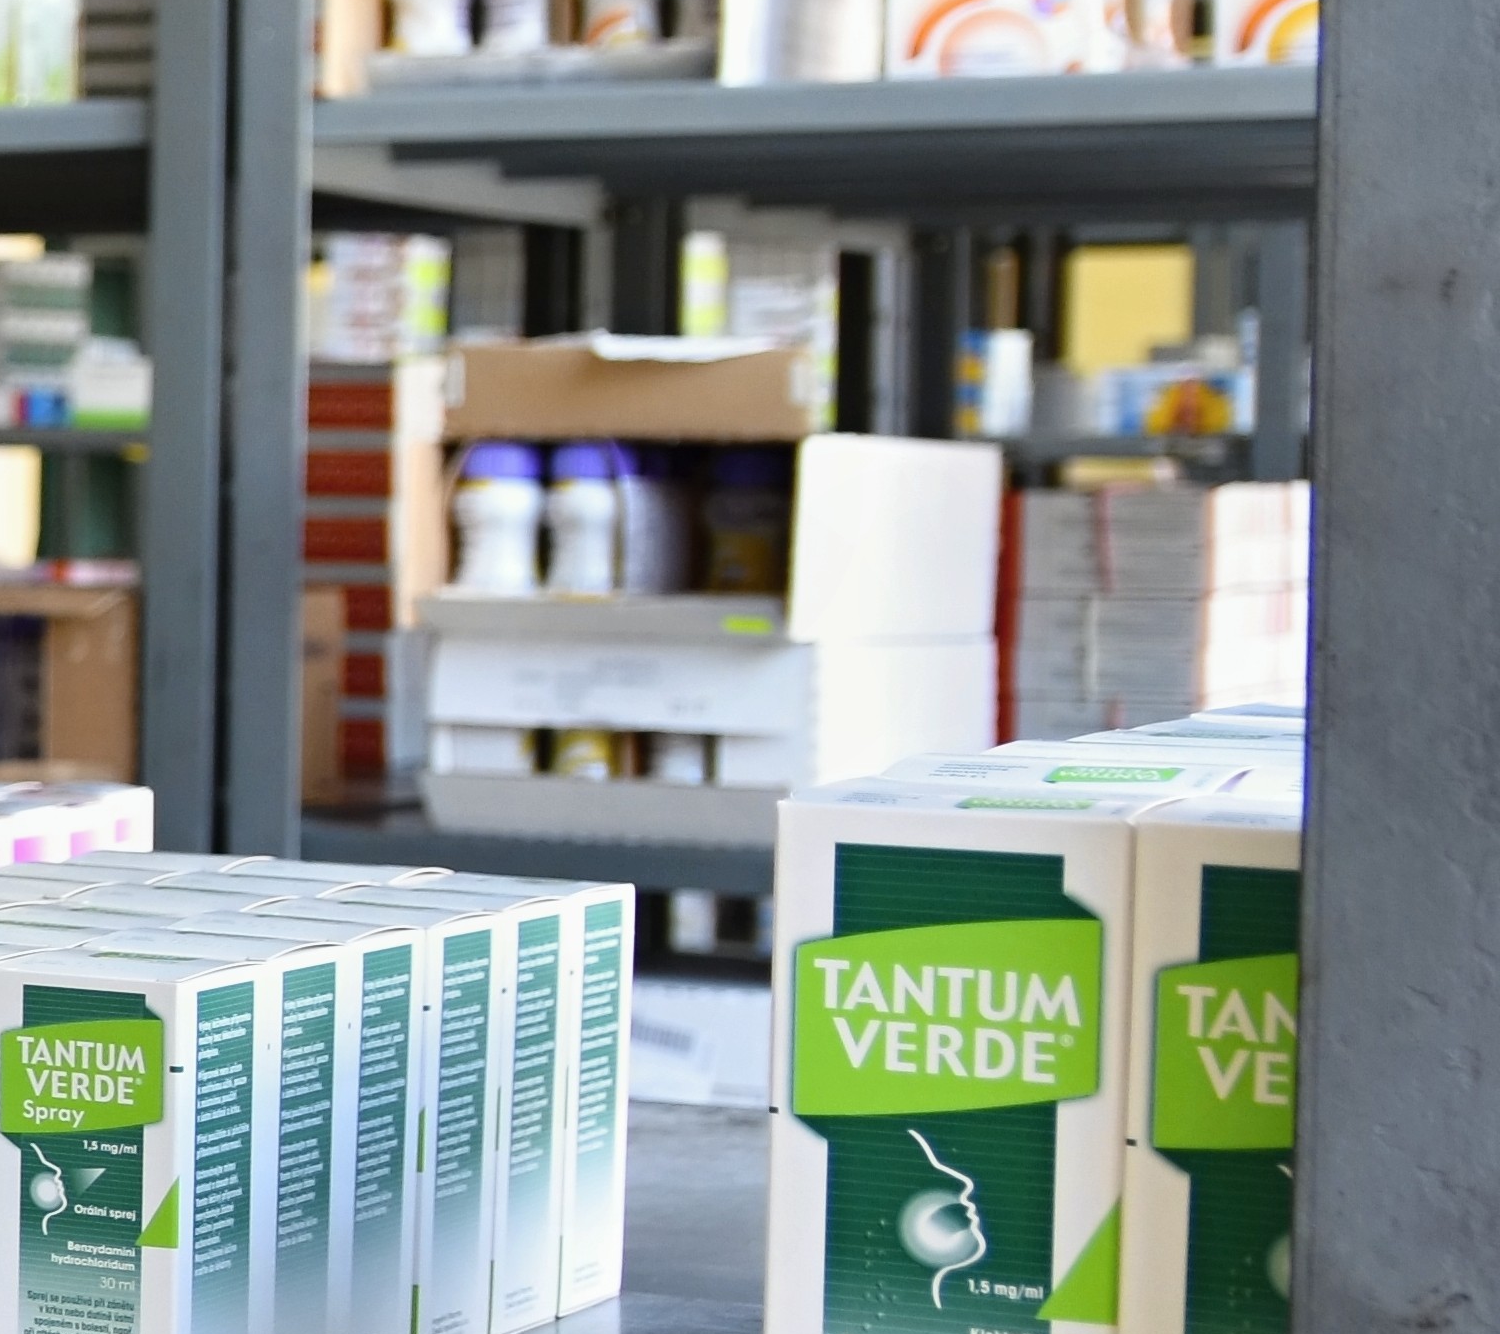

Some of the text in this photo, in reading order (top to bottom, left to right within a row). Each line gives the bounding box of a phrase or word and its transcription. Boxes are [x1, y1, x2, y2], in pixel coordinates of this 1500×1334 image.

[814, 958, 1081, 1027] TANTUM
[17, 1035, 146, 1074] TANTUM
[1198, 1046, 1289, 1104] VE
[23, 1099, 84, 1128] Spray
[83, 1140, 137, 1155] 1,5 mg/ml
[74, 1205, 136, 1221] Orální sprej
[67, 1241, 135, 1257] Benzydamini
[51, 1253, 135, 1272] hydrochloridum
[100, 1276, 135, 1291] 30 ml
[968, 1279, 1043, 1299] 1,5 mg/ml
